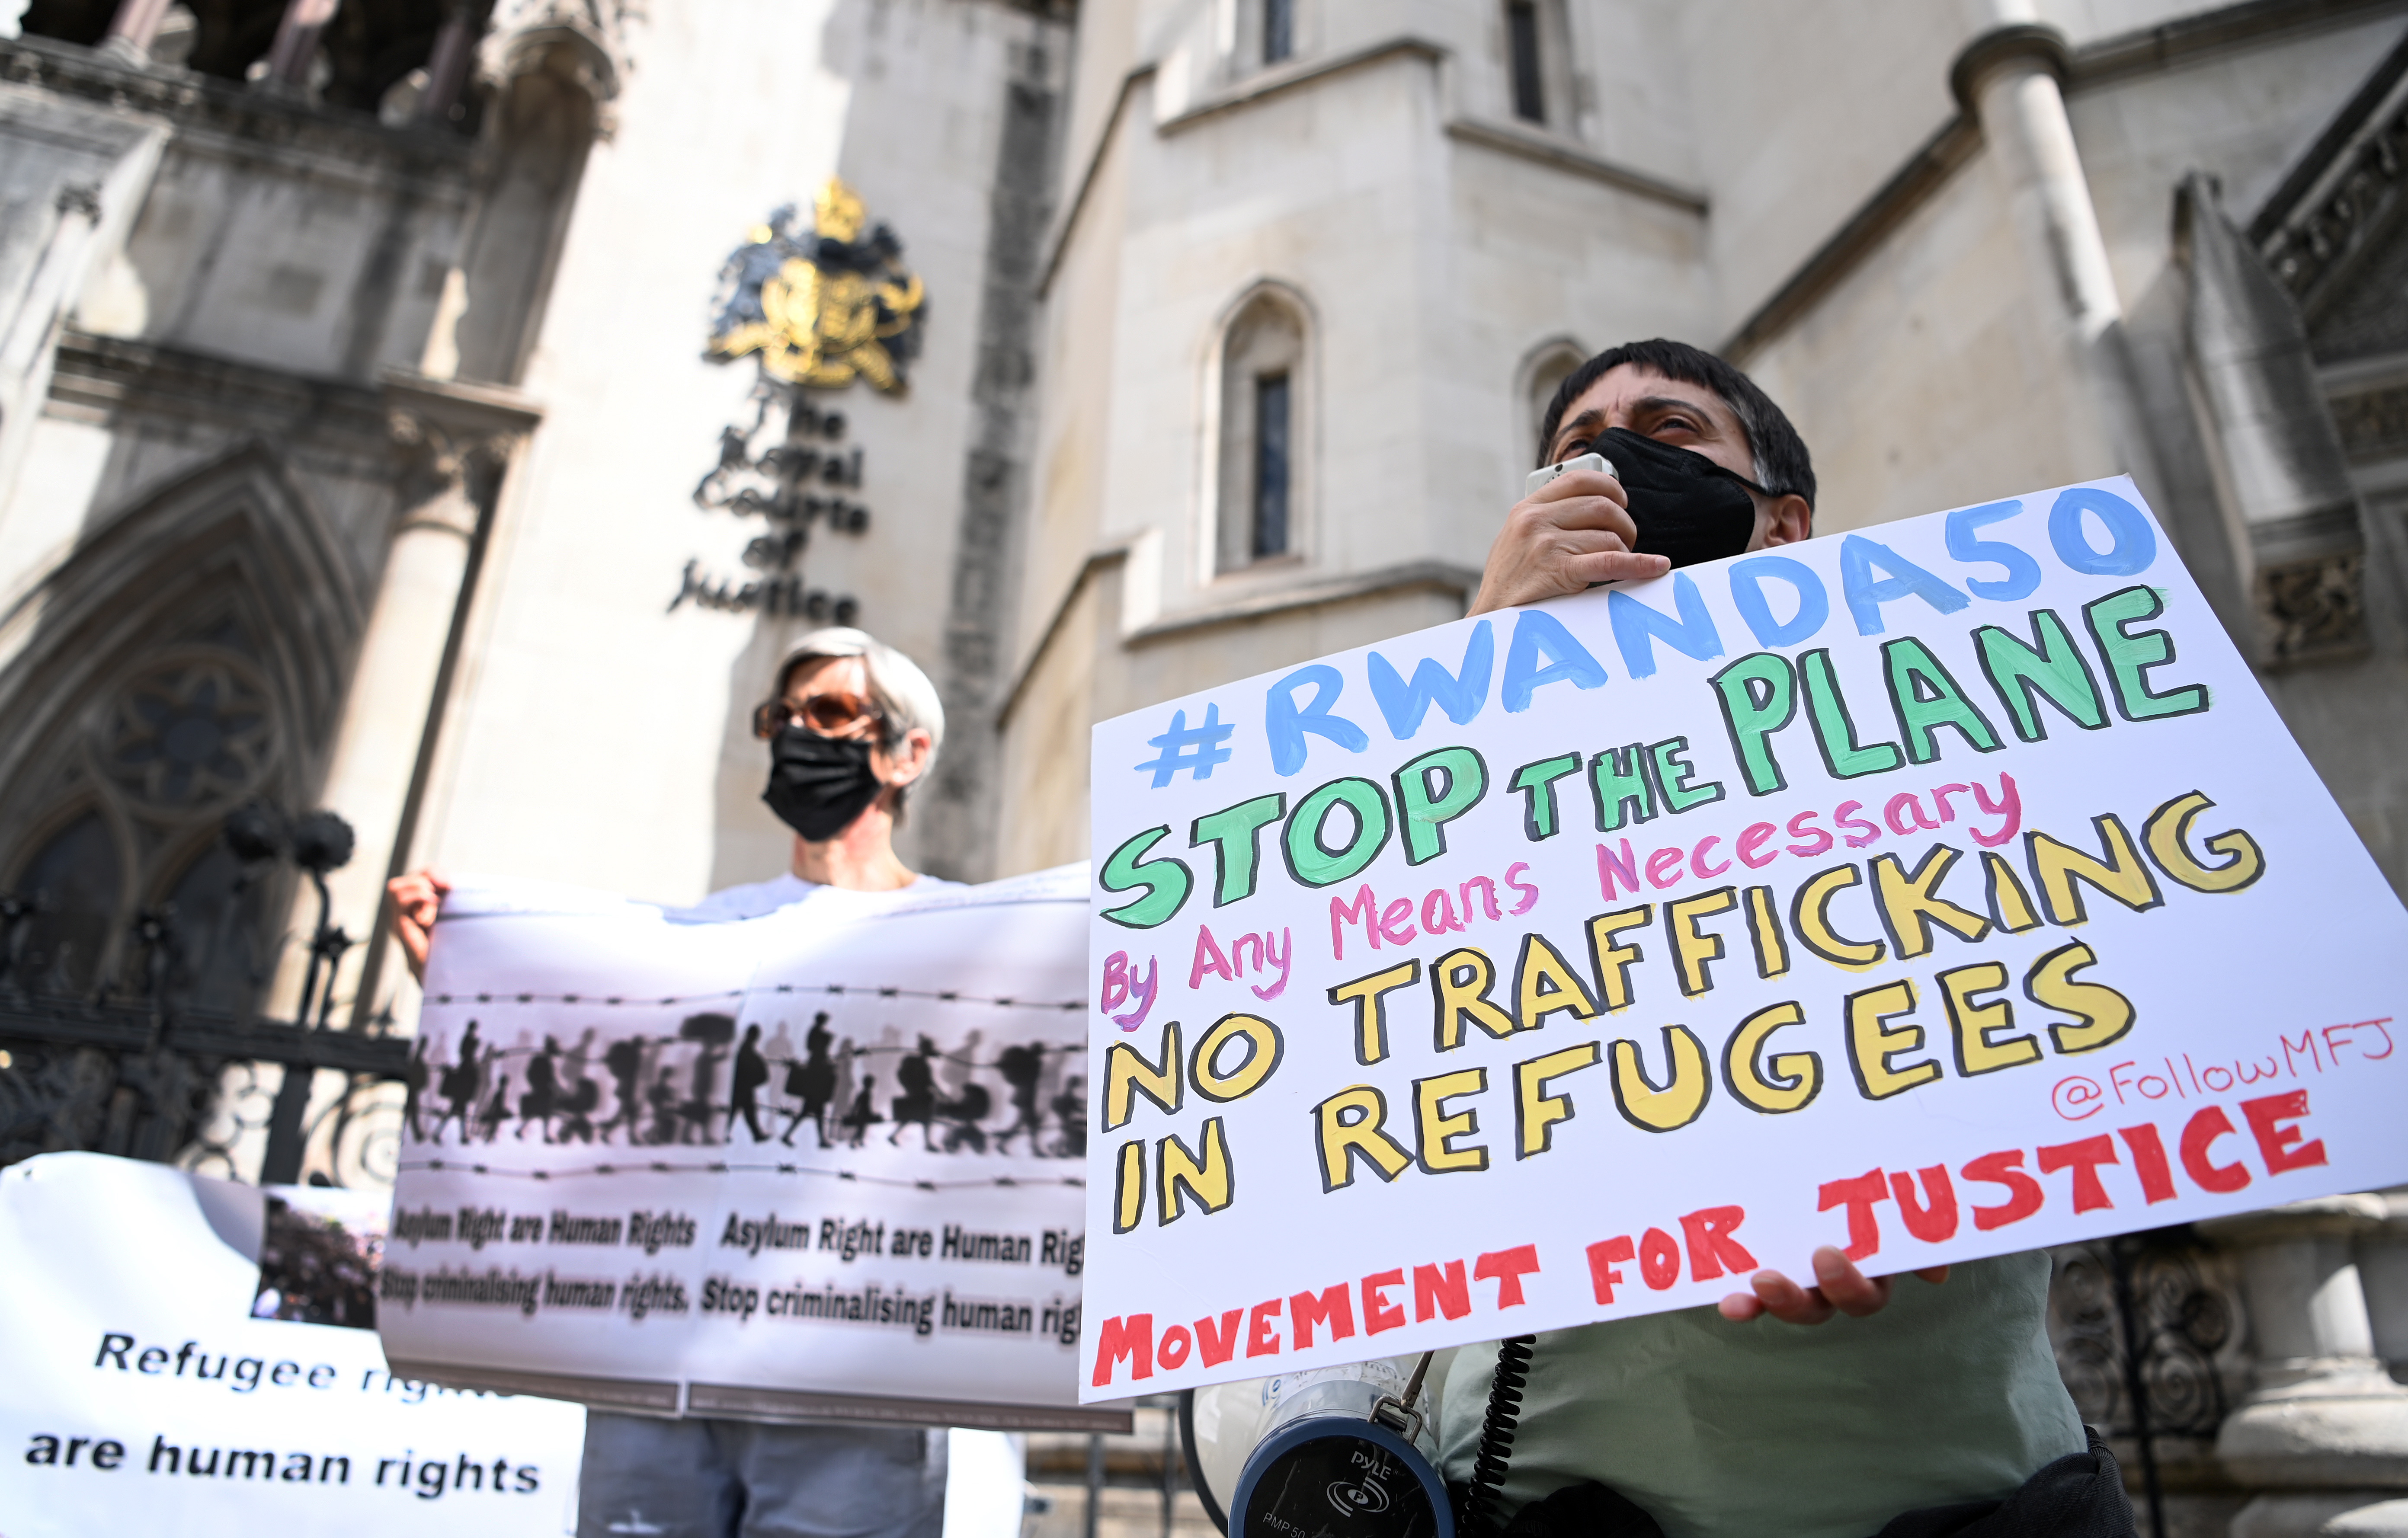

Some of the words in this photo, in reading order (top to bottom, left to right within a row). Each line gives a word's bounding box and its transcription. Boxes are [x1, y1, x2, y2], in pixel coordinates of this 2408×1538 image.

[1099, 746, 1489, 929] STOP
[1507, 736, 1726, 842] THE
[1707, 584, 2212, 796] PLANE
[1101, 950, 1158, 1032] By
[1188, 924, 1292, 1002] Any
[1330, 862, 1539, 961] Means
[1596, 771, 2022, 902] Necessary
[1102, 1012, 1284, 1133] NO
[1326, 790, 2266, 1066] TRAFFICKING
[1112, 1116, 1235, 1234] IN
[1310, 935, 2136, 1194] REFUGEES
[2052, 1017, 2393, 1121] @FollowMFJ
[509, 1215, 543, 1243] are
[549, 1209, 622, 1244] Human
[627, 1211, 696, 1255] Rights
[720, 1213, 810, 1257] Asylum
[819, 1217, 884, 1262] Right
[891, 1227, 933, 1257] are
[941, 1225, 1031, 1263] Human
[1092, 1244, 1540, 1387] MOVEMENT
[1586, 1205, 1759, 1306] FOR
[1818, 1088, 2327, 1262] JUSTICE
[701, 1277, 759, 1321] Stop
[767, 1282, 934, 1335] criminalising
[941, 1293, 1032, 1332] human
[95, 1332, 336, 1392] Refugee
[26, 1432, 125, 1470] are
[146, 1435, 351, 1484] human
[375, 1449, 541, 1499] rights
[1351, 1451, 1391, 1480] PYLE
[1263, 1512, 1290, 1532] PMP
